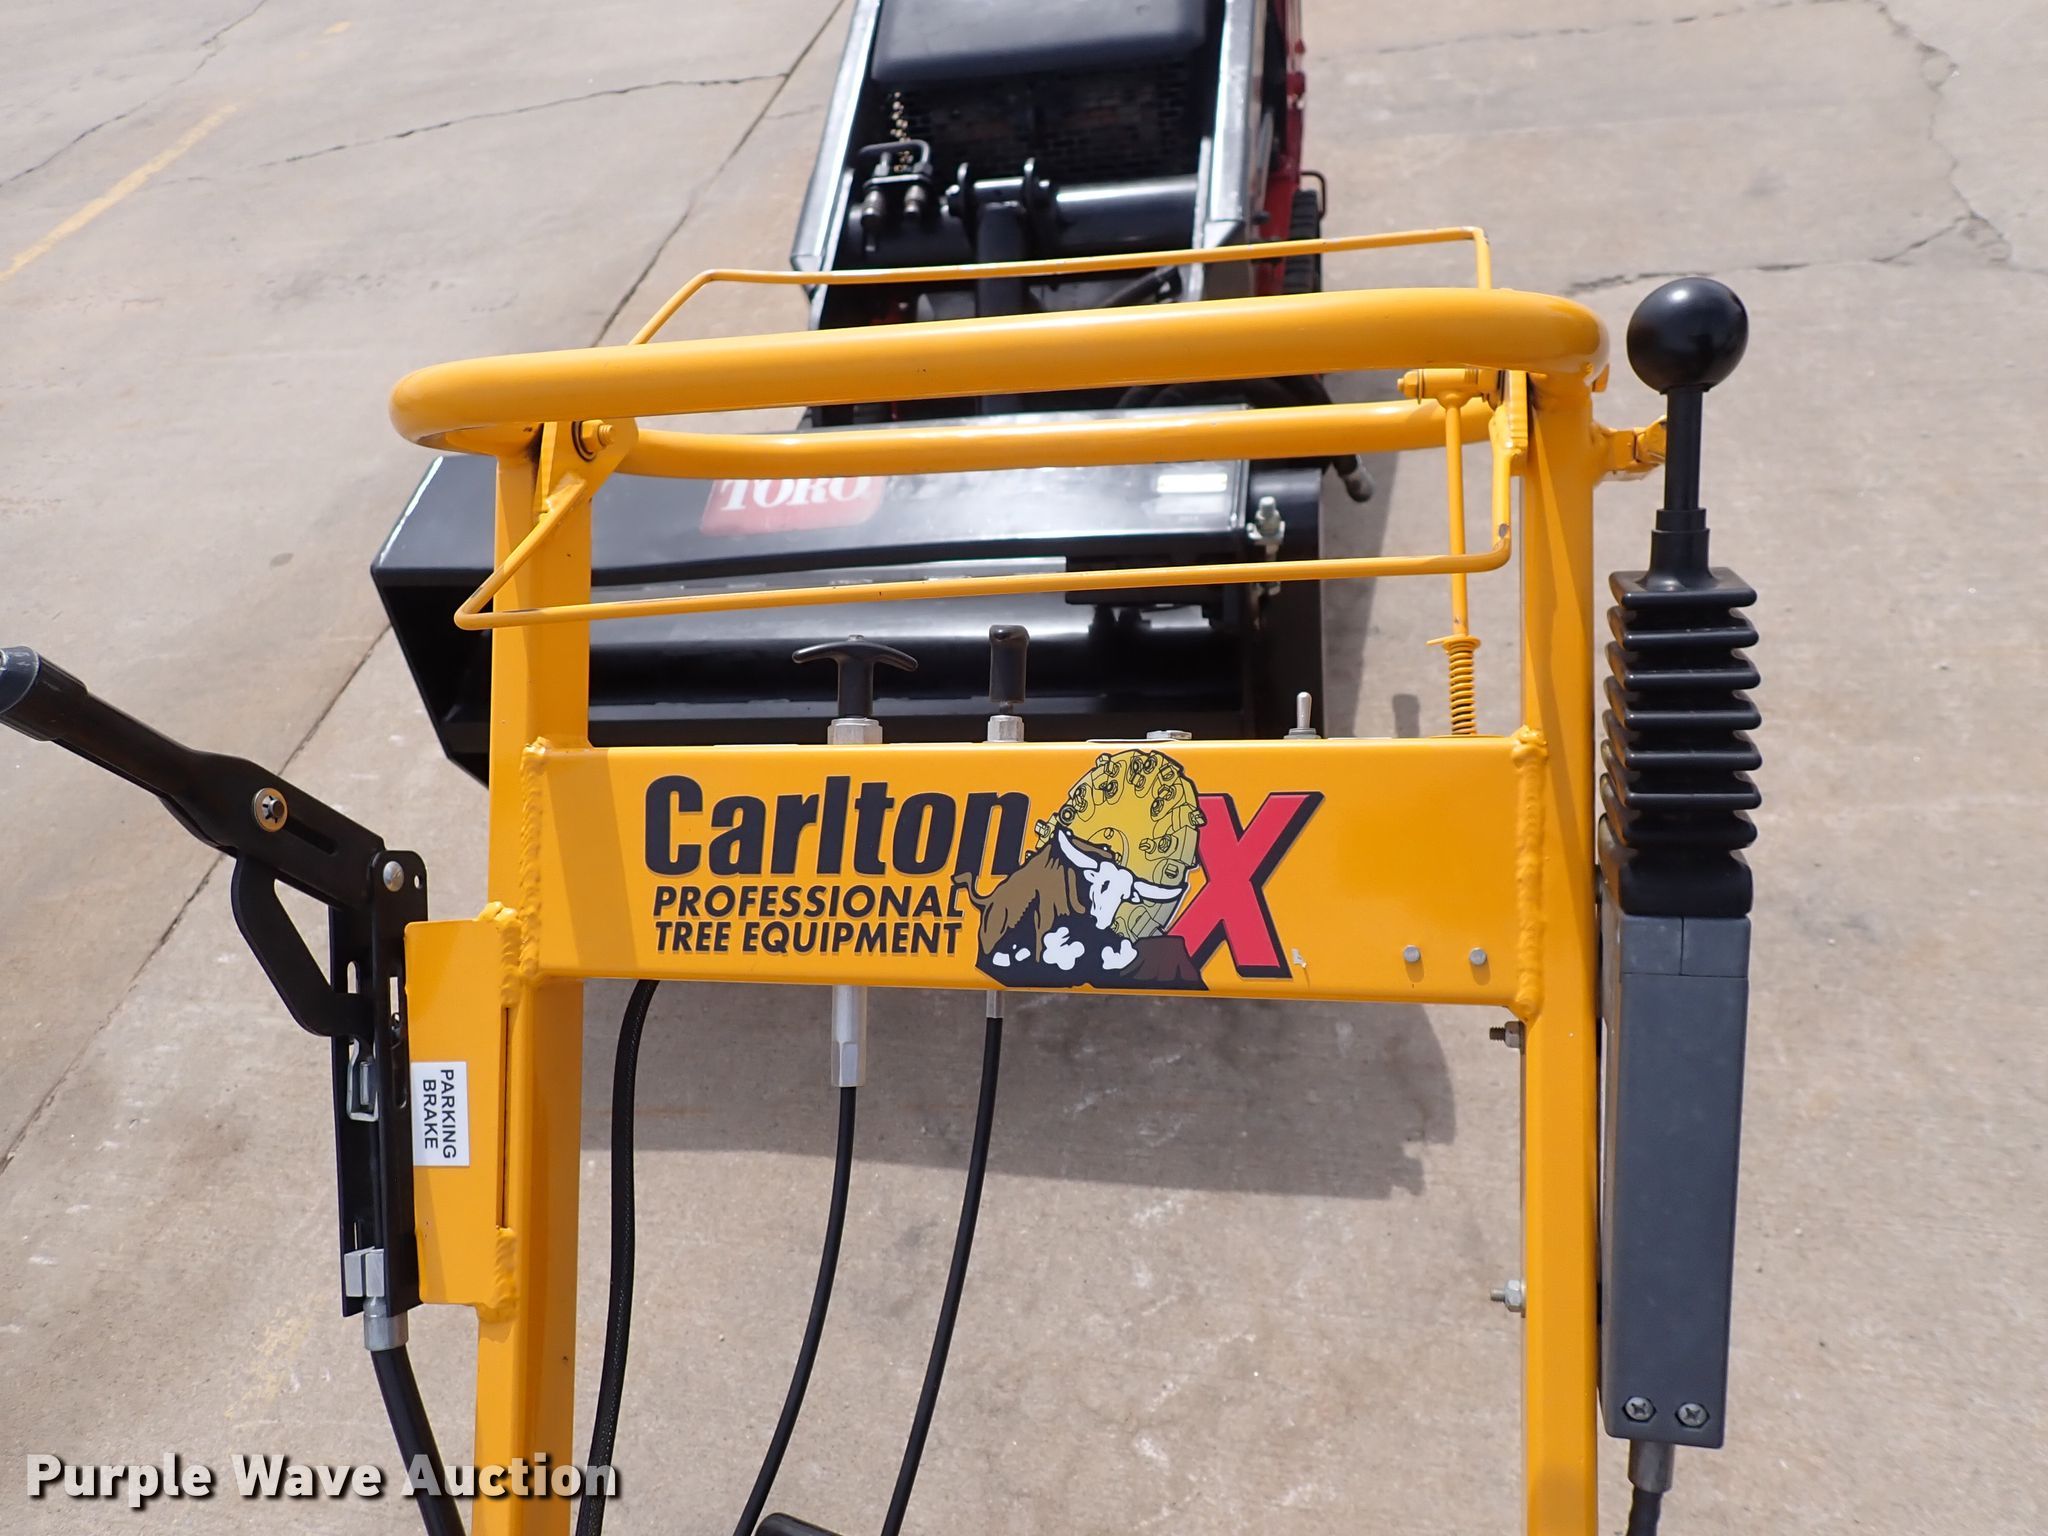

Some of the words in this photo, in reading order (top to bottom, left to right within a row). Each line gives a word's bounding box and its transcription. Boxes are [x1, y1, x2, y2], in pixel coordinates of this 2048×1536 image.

[720, 476, 872, 511] TORO
[645, 775, 1031, 876] Carlton
[653, 885, 965, 918] PROFESSIONAL
[1171, 791, 1326, 977] X
[655, 921, 732, 952] TREE
[742, 921, 963, 955] EQUIPMENT
[423, 1079, 438, 1149] BRAKE
[440, 1069, 456, 1158] PARKING
